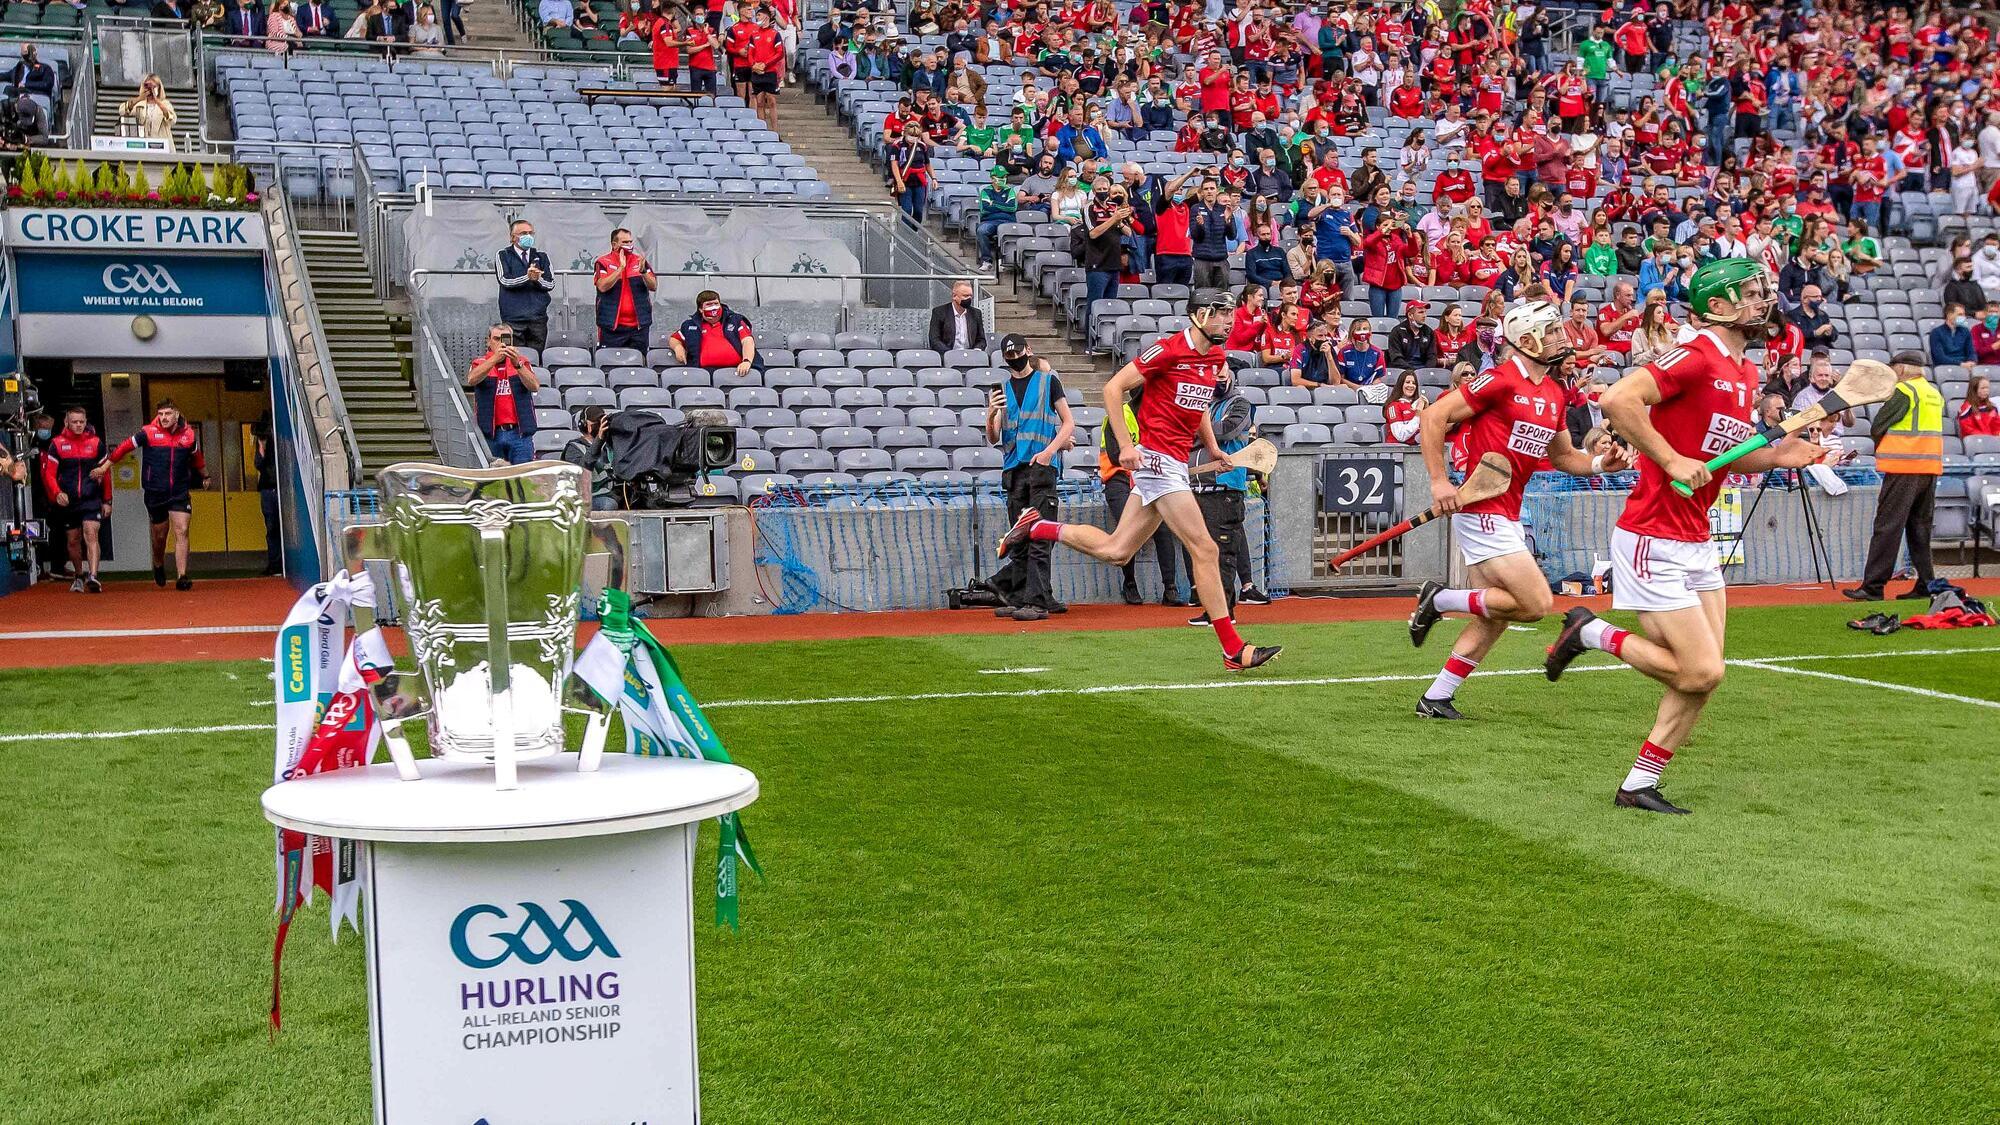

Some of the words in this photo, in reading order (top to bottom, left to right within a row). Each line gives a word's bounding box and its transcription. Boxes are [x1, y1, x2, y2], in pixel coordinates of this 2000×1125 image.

[22, 213, 144, 243] CROKE
[156, 215, 248, 244] PARK
[102, 263, 182, 294] GAA
[83, 296, 121, 306] WHERE
[123, 296, 140, 306] WE
[142, 296, 161, 307] ALL
[163, 297, 204, 307] BELONG
[1198, 367, 1205, 377] 3
[1178, 397, 1208, 410] DIREC
[1180, 384, 1214, 398] SPORT
[1716, 417, 1749, 440] SPORT
[1337, 467, 1385, 506] 32
[320, 627, 330, 649] Bord
[289, 635, 304, 693] Centra
[320, 649, 330, 669] Gáis
[676, 694, 709, 741] Centra
[450, 898, 622, 969] GAA
[461, 971, 619, 1010] HURLING
[462, 1009, 562, 1029] ALL-IRELAND
[566, 1004, 621, 1020] SENIOR
[463, 1022, 621, 1050] CHAMPIONSHIP
